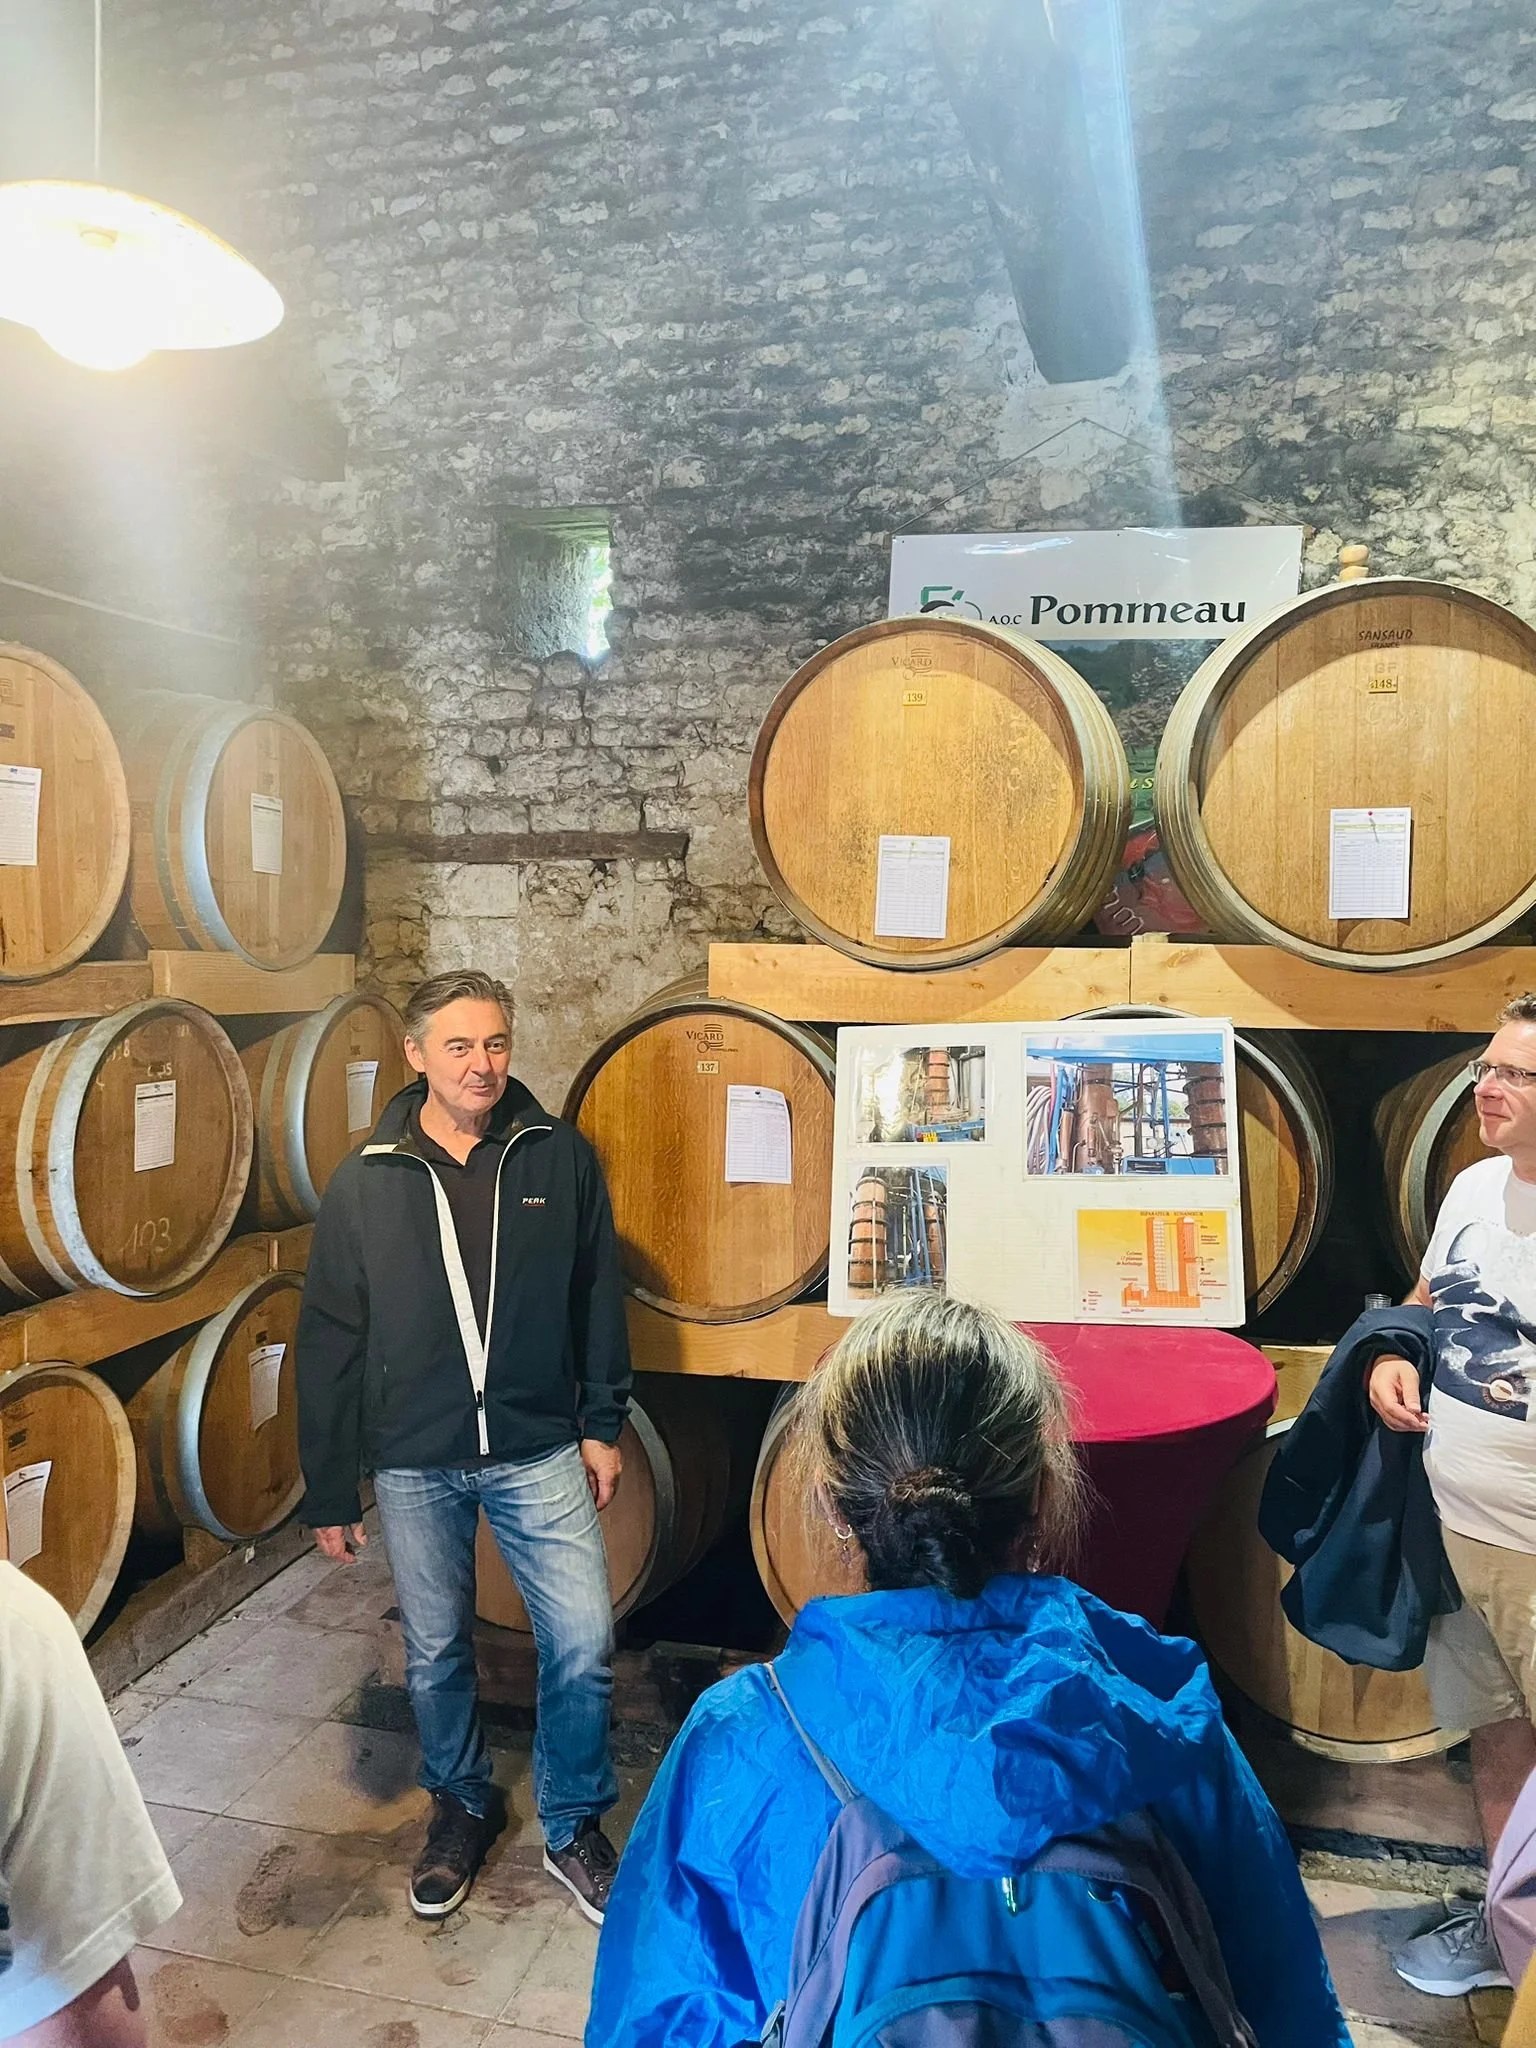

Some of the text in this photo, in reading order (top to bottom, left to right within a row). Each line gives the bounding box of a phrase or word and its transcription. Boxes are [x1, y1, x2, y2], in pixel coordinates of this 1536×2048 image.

[1030, 595, 1246, 625] Pommeau
[1358, 628, 1413, 641] SANSAUD
[907, 692, 923, 702] 139
[685, 1031, 724, 1041] VICARD
[701, 1063, 715, 1072] 137
[522, 1197, 546, 1205] PEAK
